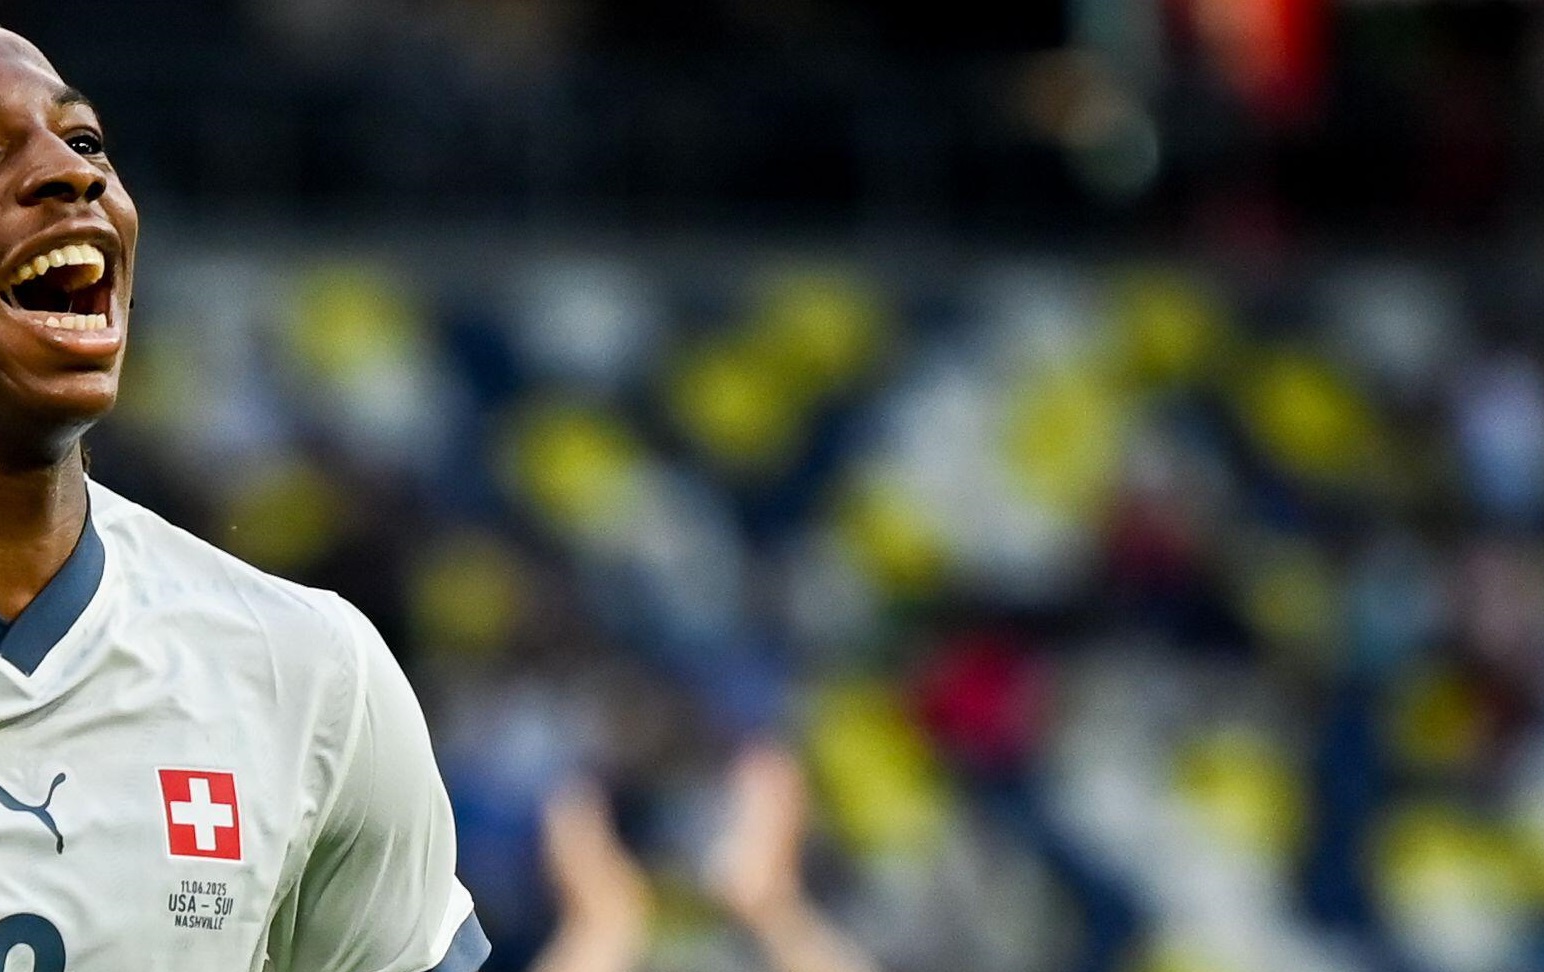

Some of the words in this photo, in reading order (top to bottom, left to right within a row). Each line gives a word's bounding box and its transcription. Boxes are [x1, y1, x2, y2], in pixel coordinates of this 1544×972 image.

[181, 880, 227, 896] 11.06.2025
[168, 893, 196, 913] USA
[214, 896, 234, 915] SUI
[174, 914, 224, 930] NASHVILLE
